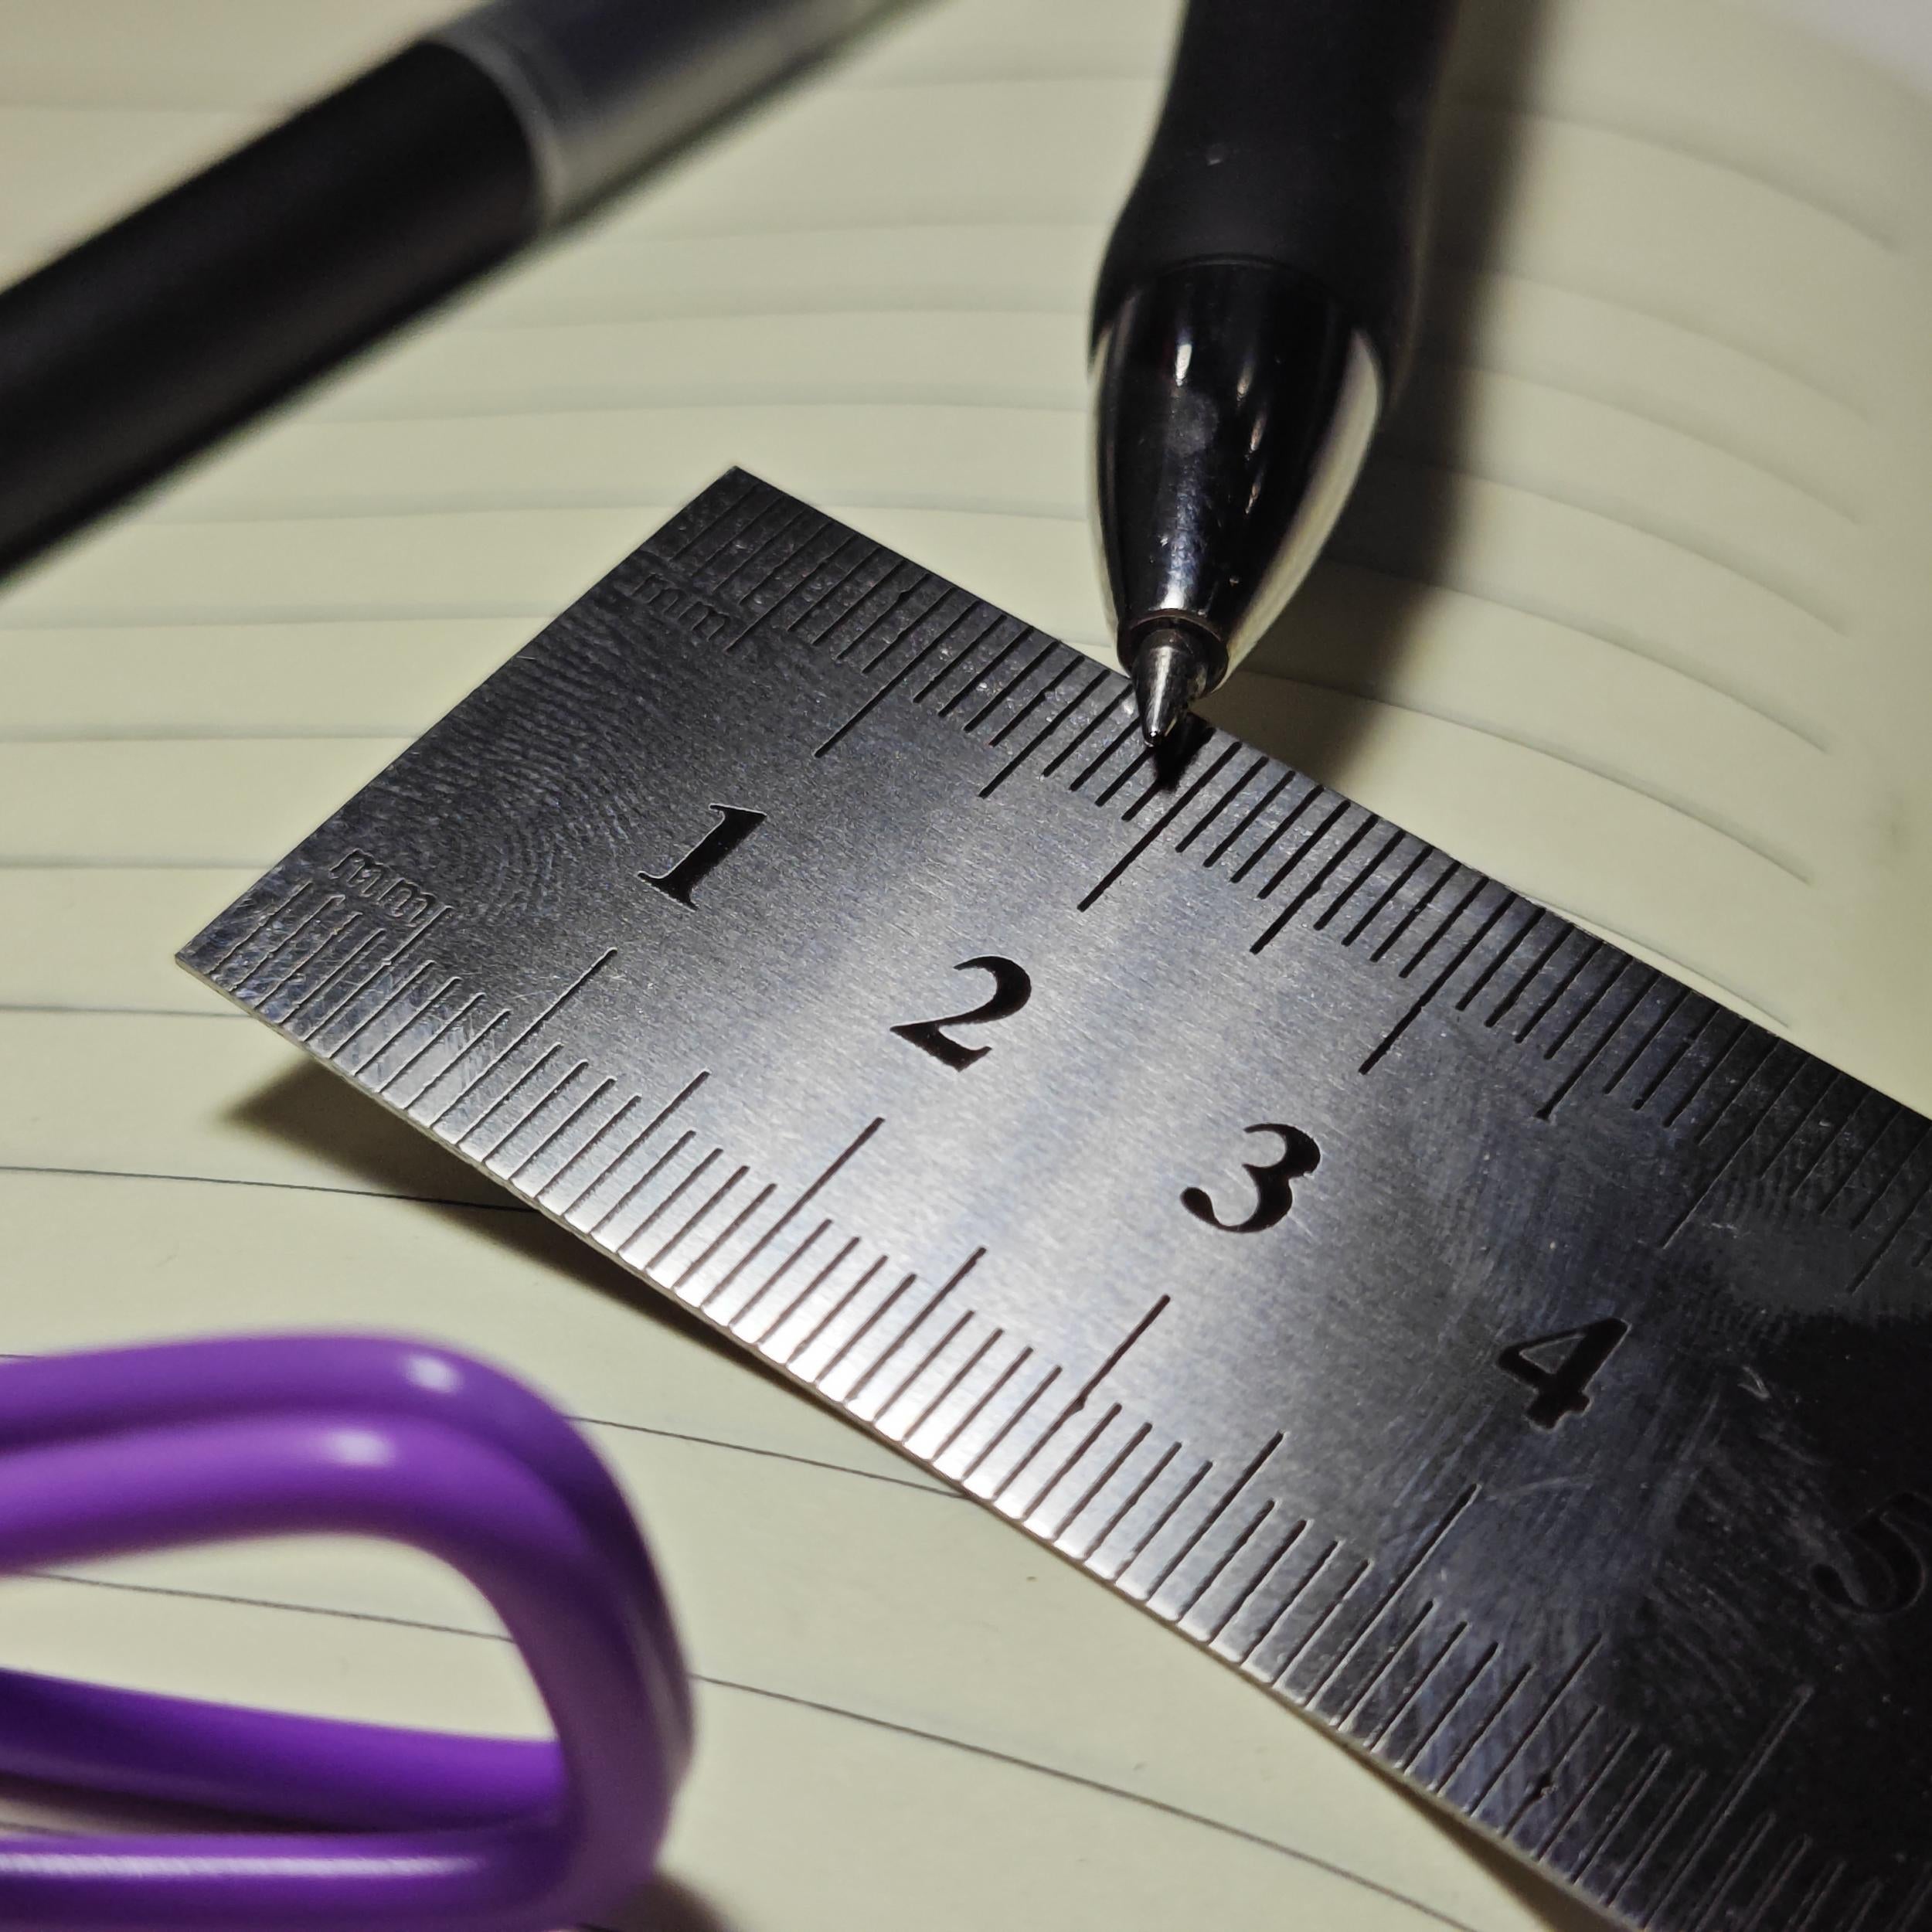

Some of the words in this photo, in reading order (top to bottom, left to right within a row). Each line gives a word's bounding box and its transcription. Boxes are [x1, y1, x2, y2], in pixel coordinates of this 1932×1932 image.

[329, 848, 438, 926] mm
[637, 804, 767, 910] 1
[889, 955, 1032, 1072] 2
[1181, 1123, 1321, 1233] 3
[1497, 1318, 1631, 1430] 4
[1809, 1492, 1932, 1617] 5
